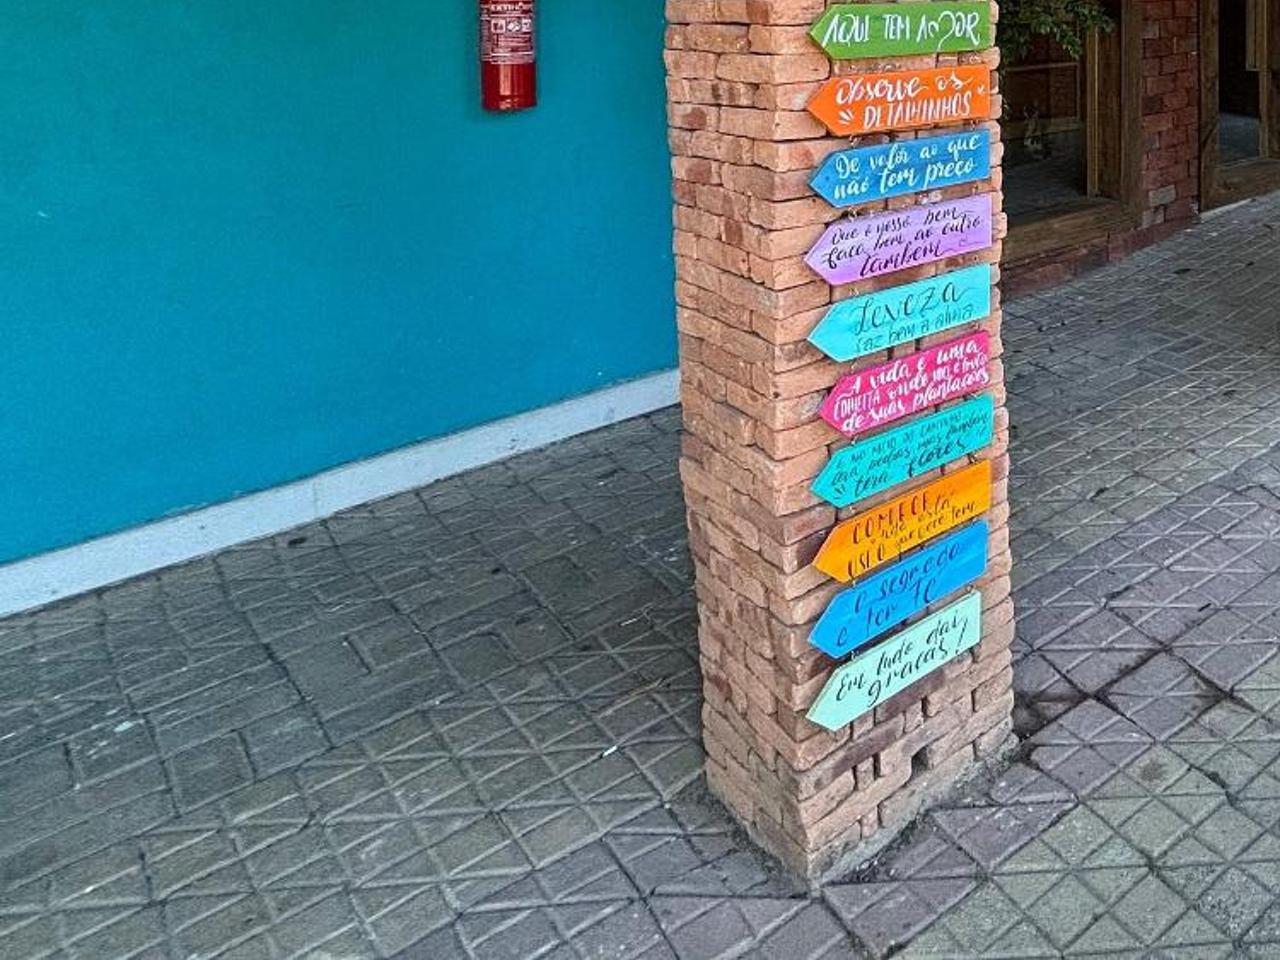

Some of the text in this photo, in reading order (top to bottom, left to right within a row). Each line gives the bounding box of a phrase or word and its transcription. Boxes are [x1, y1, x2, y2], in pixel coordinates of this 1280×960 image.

[822, 13, 870, 47] AQUI
[883, 13, 910, 41] TEM
[879, 168, 919, 193] tem
